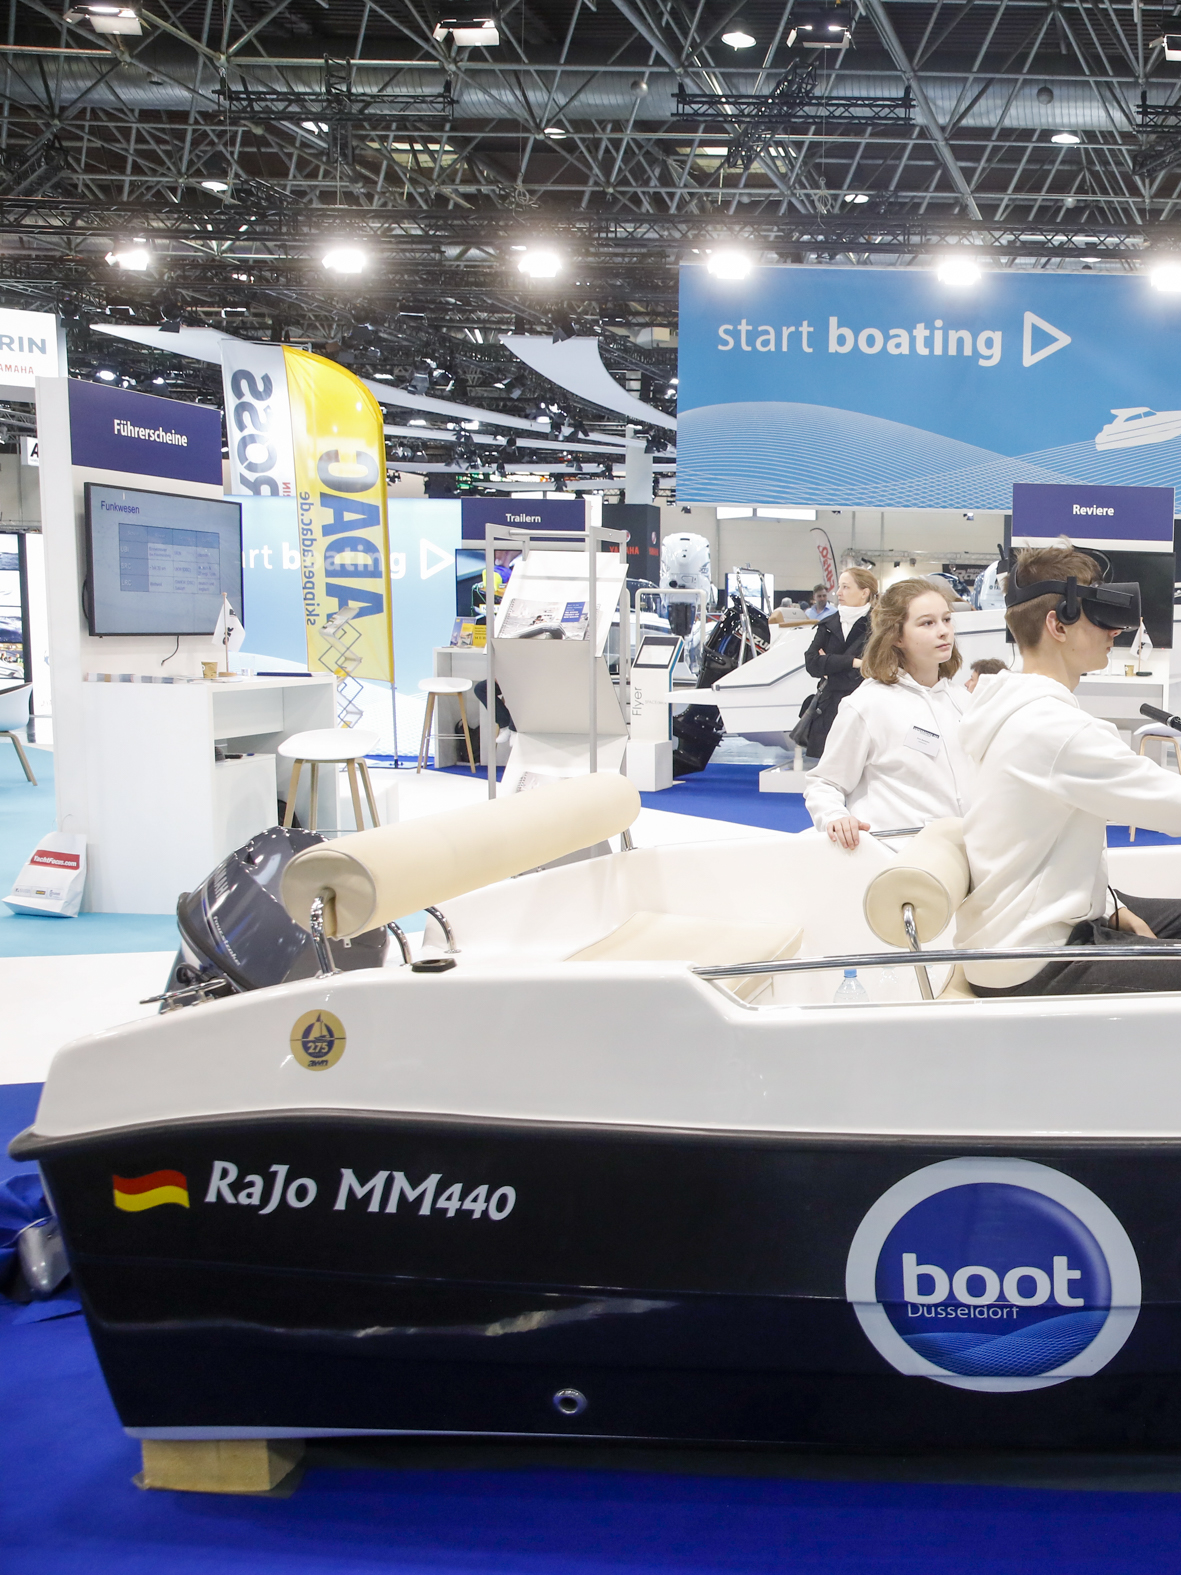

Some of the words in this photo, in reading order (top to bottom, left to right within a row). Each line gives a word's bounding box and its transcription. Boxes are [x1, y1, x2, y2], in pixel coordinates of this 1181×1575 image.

[717, 318, 814, 353] start
[828, 316, 1003, 367] boating
[113, 419, 188, 447] Führerscheine
[100, 500, 141, 514] Funkwesen
[1072, 504, 1115, 516] Reviere
[505, 513, 542, 523] Trailern
[609, 545, 640, 555] YAAHA
[631, 686, 645, 716] Flyer
[307, 1042, 329, 1053] 275
[204, 1159, 318, 1214] RaJo
[333, 1167, 517, 1221] MM440
[902, 1252, 1085, 1308] boot
